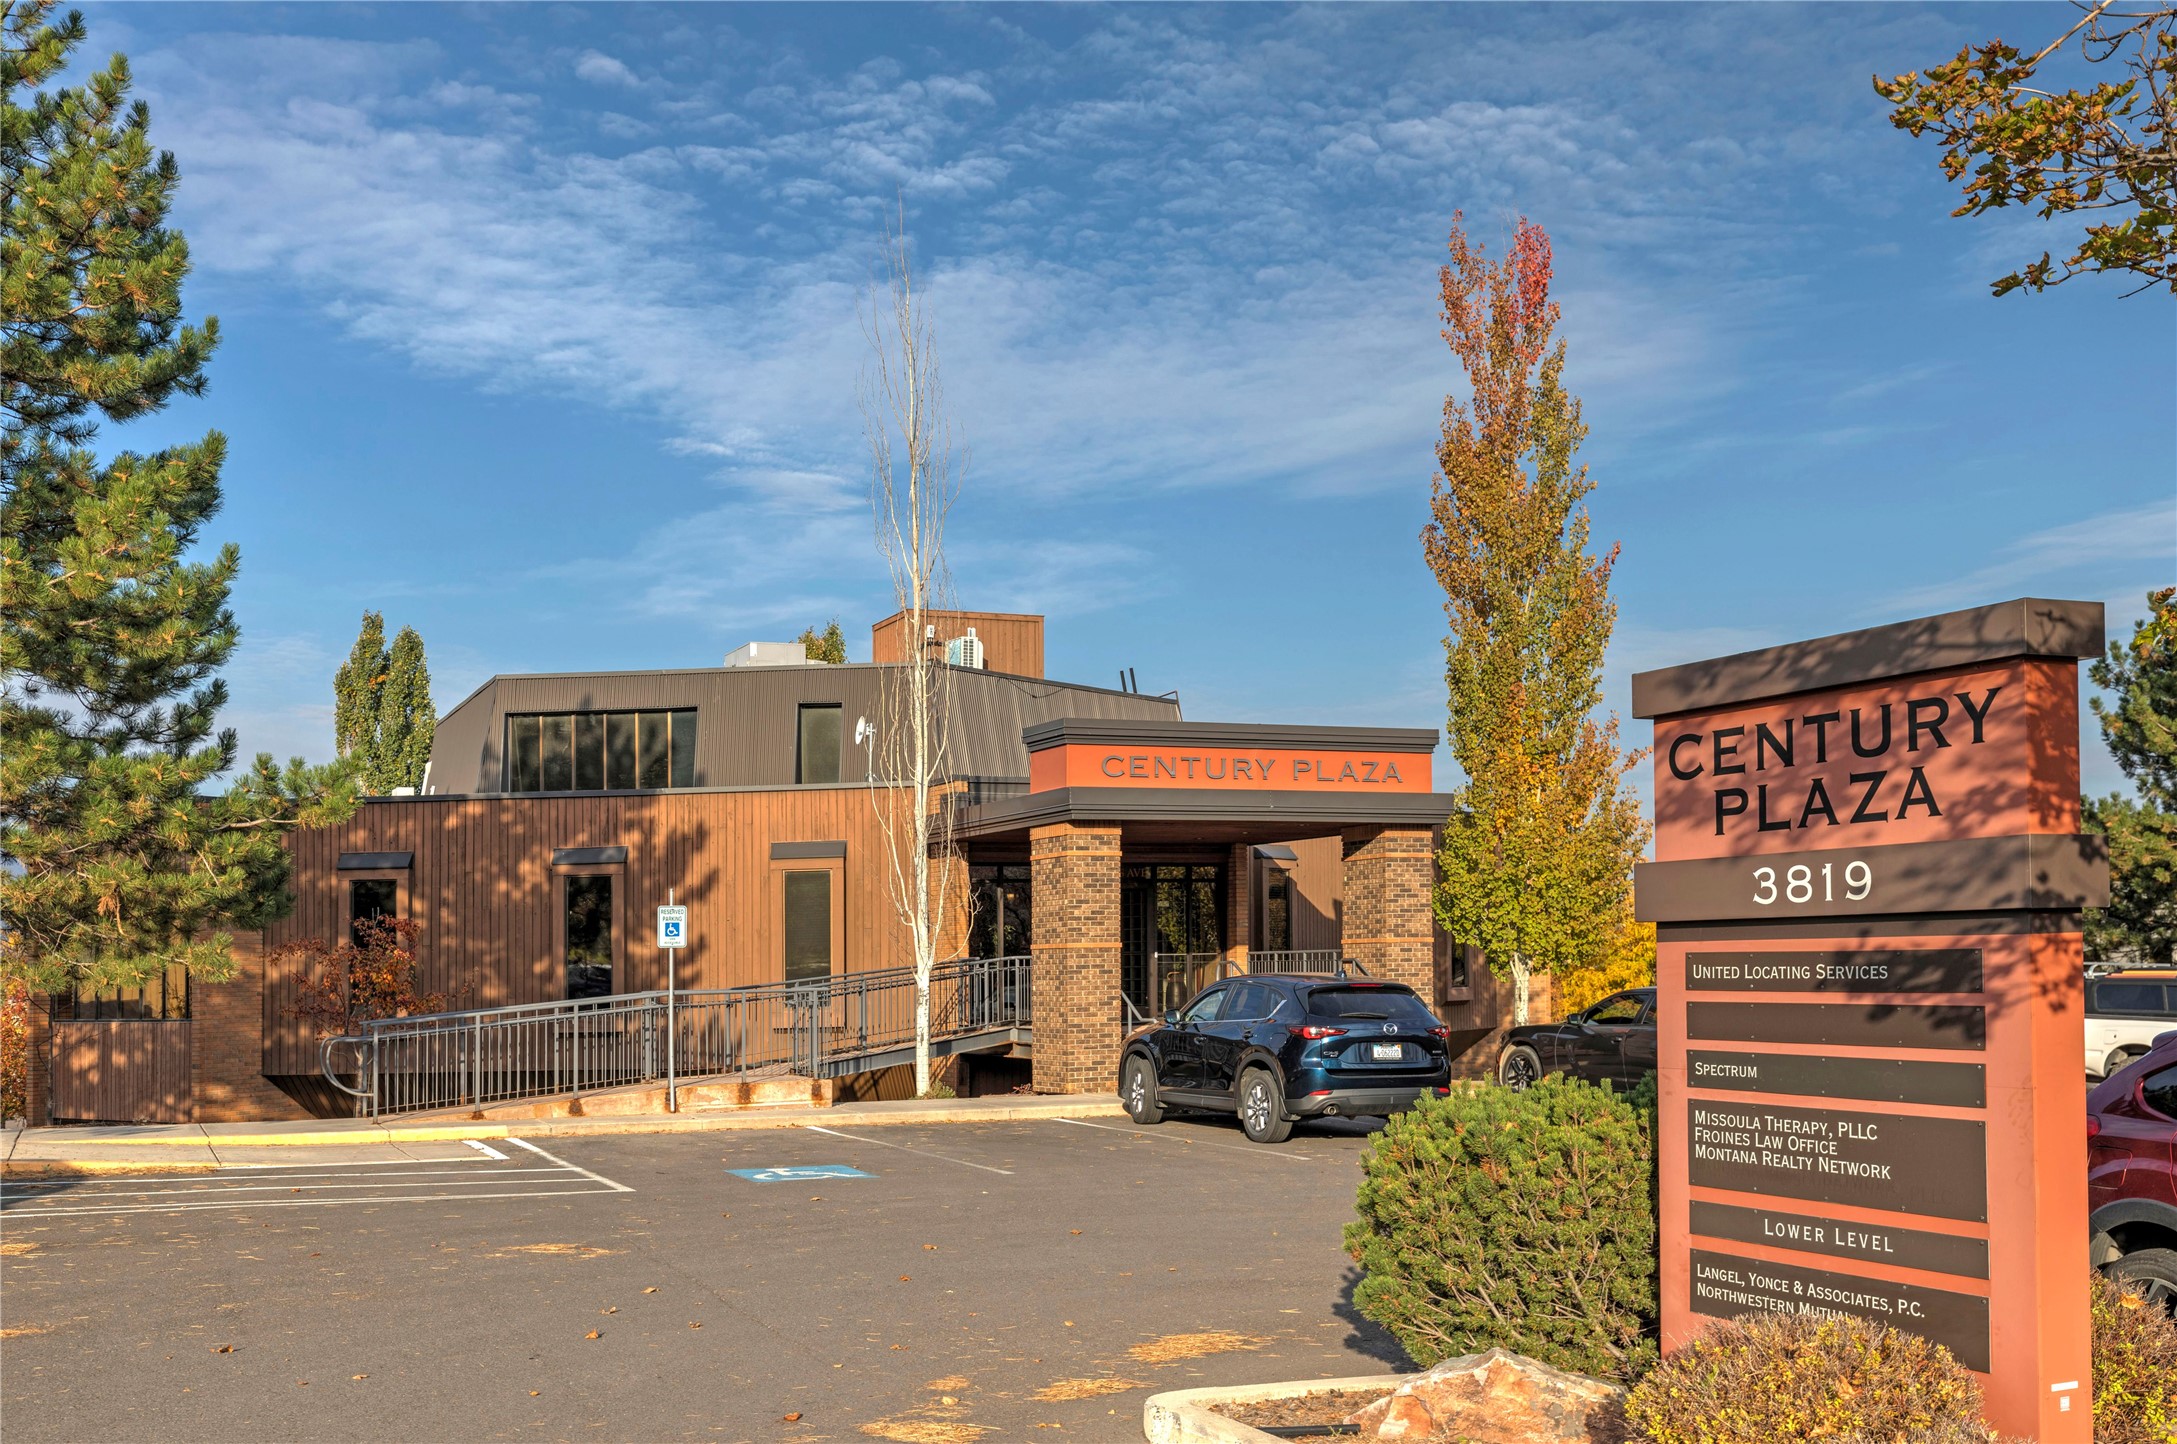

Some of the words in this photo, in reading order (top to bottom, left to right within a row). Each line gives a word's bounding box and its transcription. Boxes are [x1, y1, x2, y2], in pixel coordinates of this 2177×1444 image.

[1668, 687, 2003, 781] CENTURY
[1101, 755, 1276, 780] CENTURY
[1293, 759, 1404, 783] PLAZA
[1715, 766, 1943, 836] PLAZA
[1752, 860, 1873, 905] 3819
[1693, 964, 1740, 979] UNITED
[1744, 964, 1811, 980] LOCATING
[1815, 963, 1888, 979] SERVICES
[1695, 1061, 1758, 1079] SPECTRUM
[1695, 1109, 1762, 1130] MISSOULA
[1764, 1115, 1833, 1140] THERAPY,
[1838, 1121, 1878, 1141] PLLC
[1695, 1126, 1751, 1147] FROINES
[1755, 1132, 1784, 1150] LAW
[1787, 1135, 1838, 1156] OFFICE
[1695, 1143, 1758, 1165] MONTANA
[1762, 1150, 1813, 1171] REALTY
[1818, 1156, 1891, 1180] NETWORK
[1764, 1218, 1825, 1243] LOWER
[1835, 1227, 1894, 1253] LEVEL
[1697, 1263, 1746, 1288] LANGEL,
[1748, 1272, 1790, 1293] YONCE
[1793, 1280, 1803, 1296] &
[1806, 1283, 1893, 1315] ASSOCIATES,
[1897, 1298, 1926, 1318] P.C.
[1697, 1282, 1794, 1314] NORTHWESTERN
